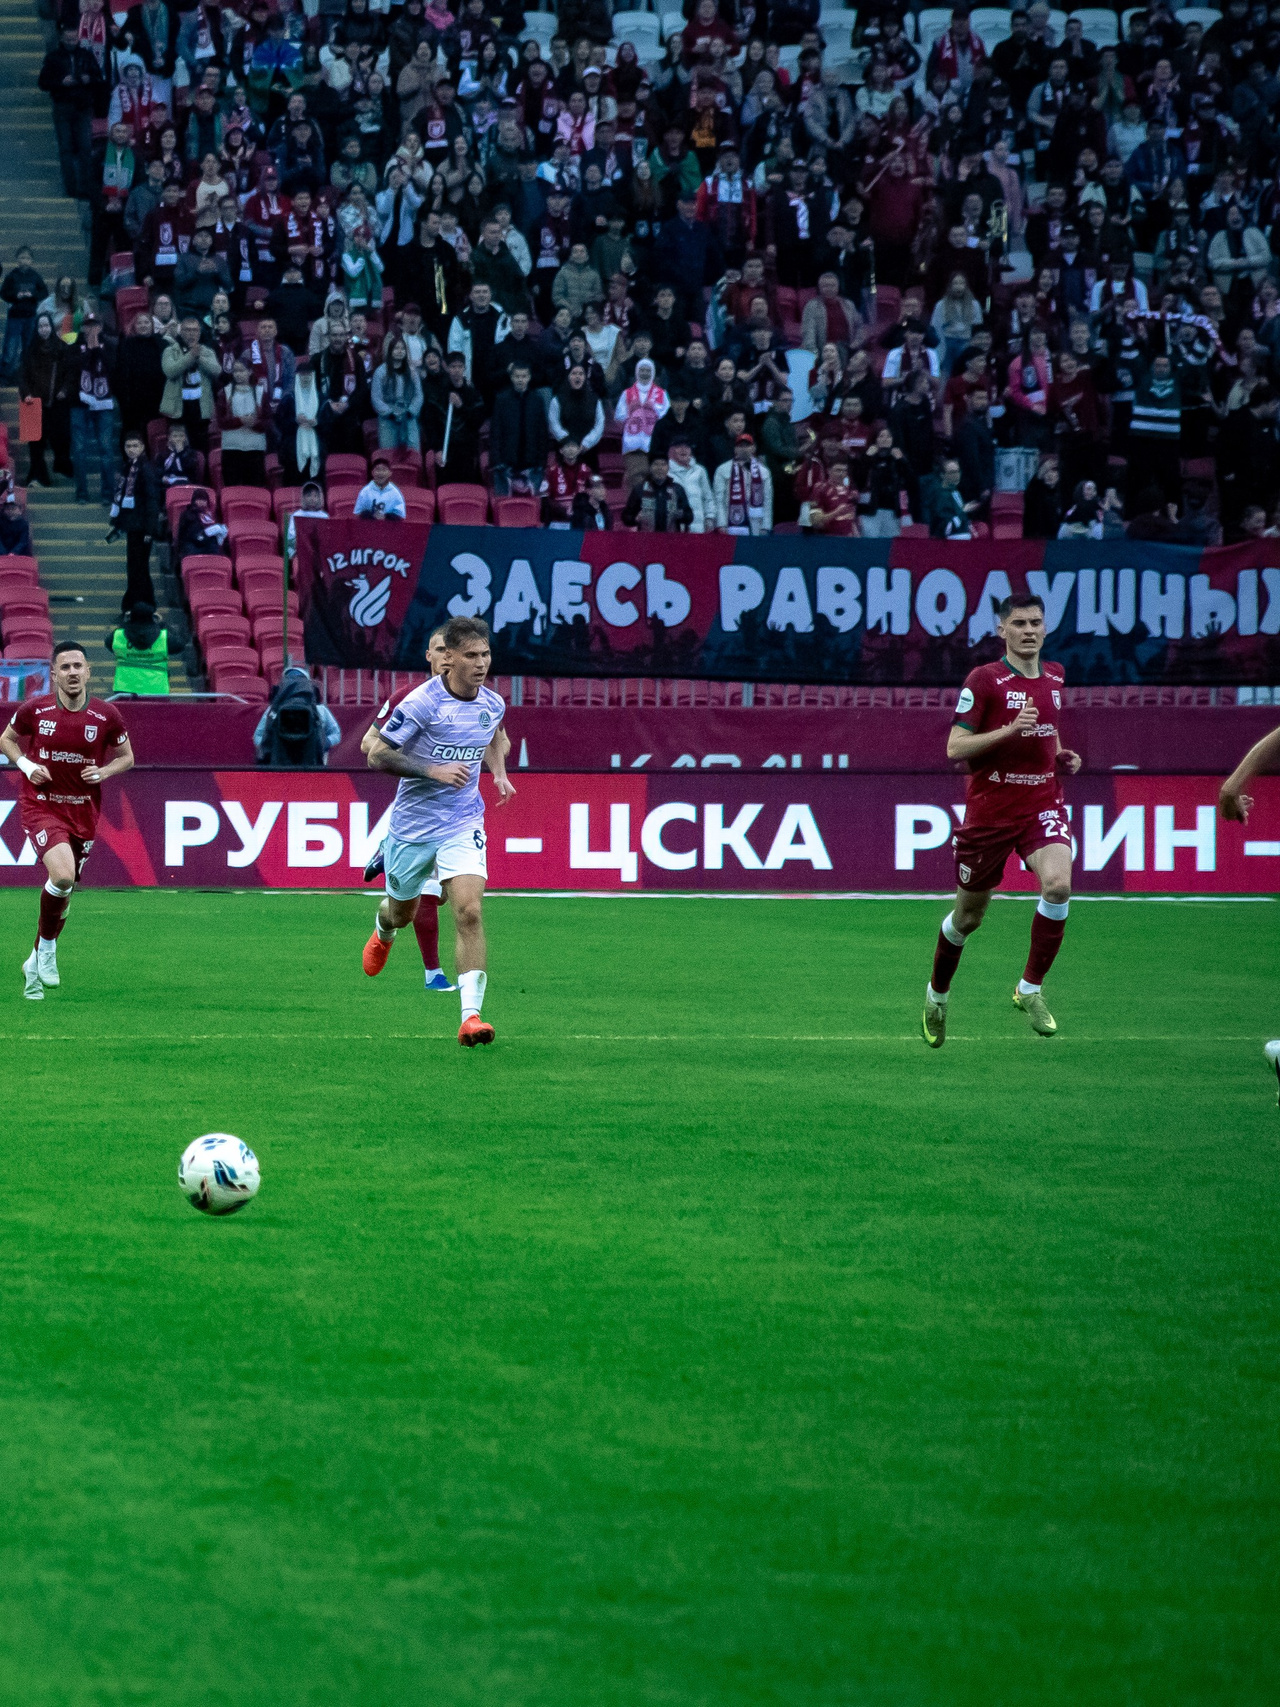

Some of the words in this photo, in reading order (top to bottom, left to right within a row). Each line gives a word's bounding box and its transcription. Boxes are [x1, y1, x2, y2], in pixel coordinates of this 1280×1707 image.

[350, 547, 411, 579] ИГРОК
[446, 552, 691, 636] ЗДЕСЬ
[1006, 691, 1027, 701] FON
[1006, 700, 1027, 709] BET
[39, 719, 57, 728] FON
[39, 727, 55, 736] BET
[164, 800, 394, 868] РУБИ
[570, 801, 834, 883] ЦСКА
